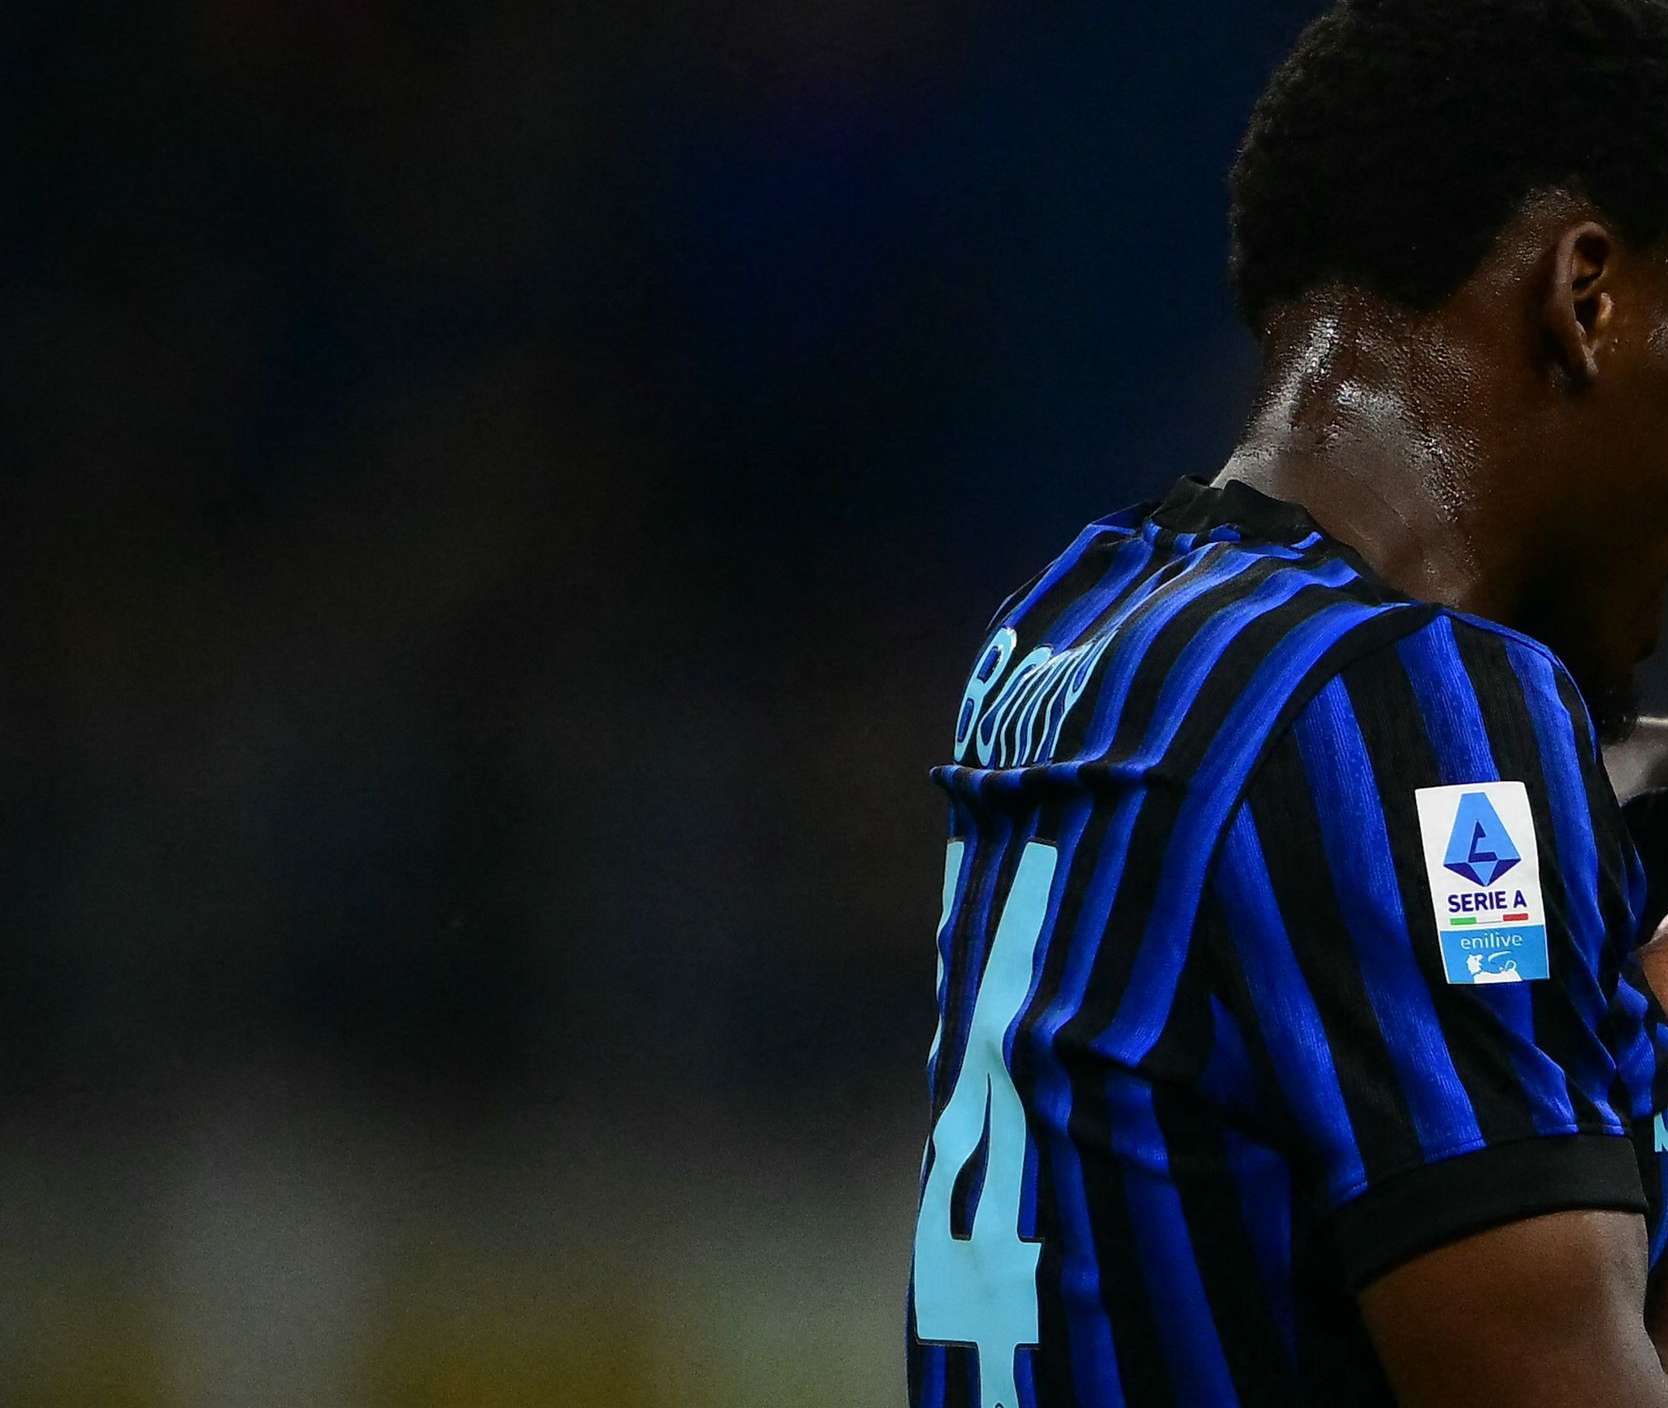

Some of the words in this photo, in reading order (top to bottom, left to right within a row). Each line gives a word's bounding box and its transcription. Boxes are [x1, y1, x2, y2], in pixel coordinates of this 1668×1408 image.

[1448, 891, 1508, 913] SERIE
[1513, 890, 1528, 908] A
[1460, 932, 1524, 950] enilive
